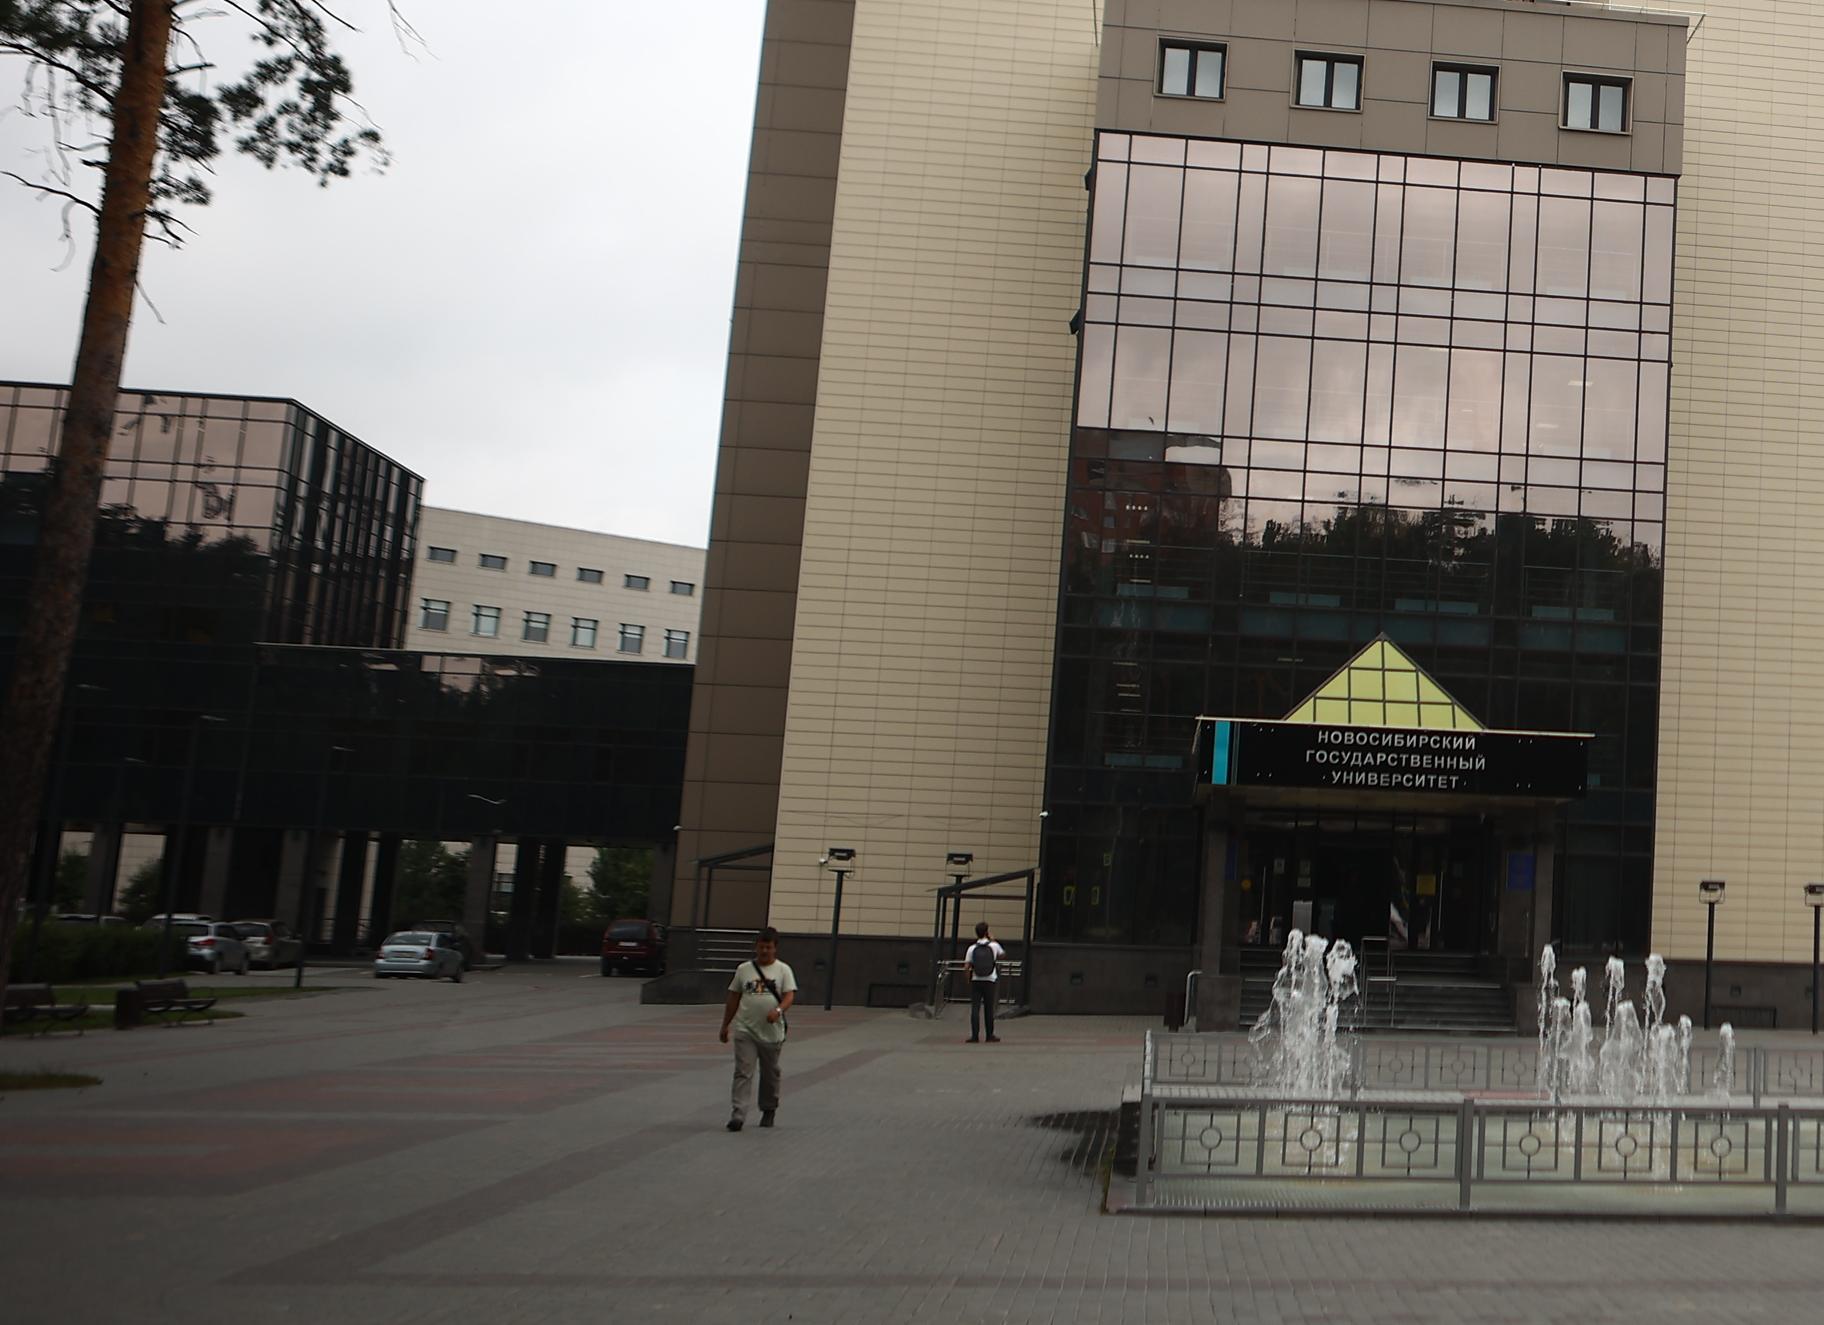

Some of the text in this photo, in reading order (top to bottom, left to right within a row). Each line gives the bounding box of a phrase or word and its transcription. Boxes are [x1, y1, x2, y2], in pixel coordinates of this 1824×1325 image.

[1318, 730, 1477, 750] НОВОСИБИРСКИЙ
[1305, 750, 1487, 770] ГОСУДАРСТВЕННЫЙ
[1331, 771, 1460, 789] УНИВЕРСИТЕТ
